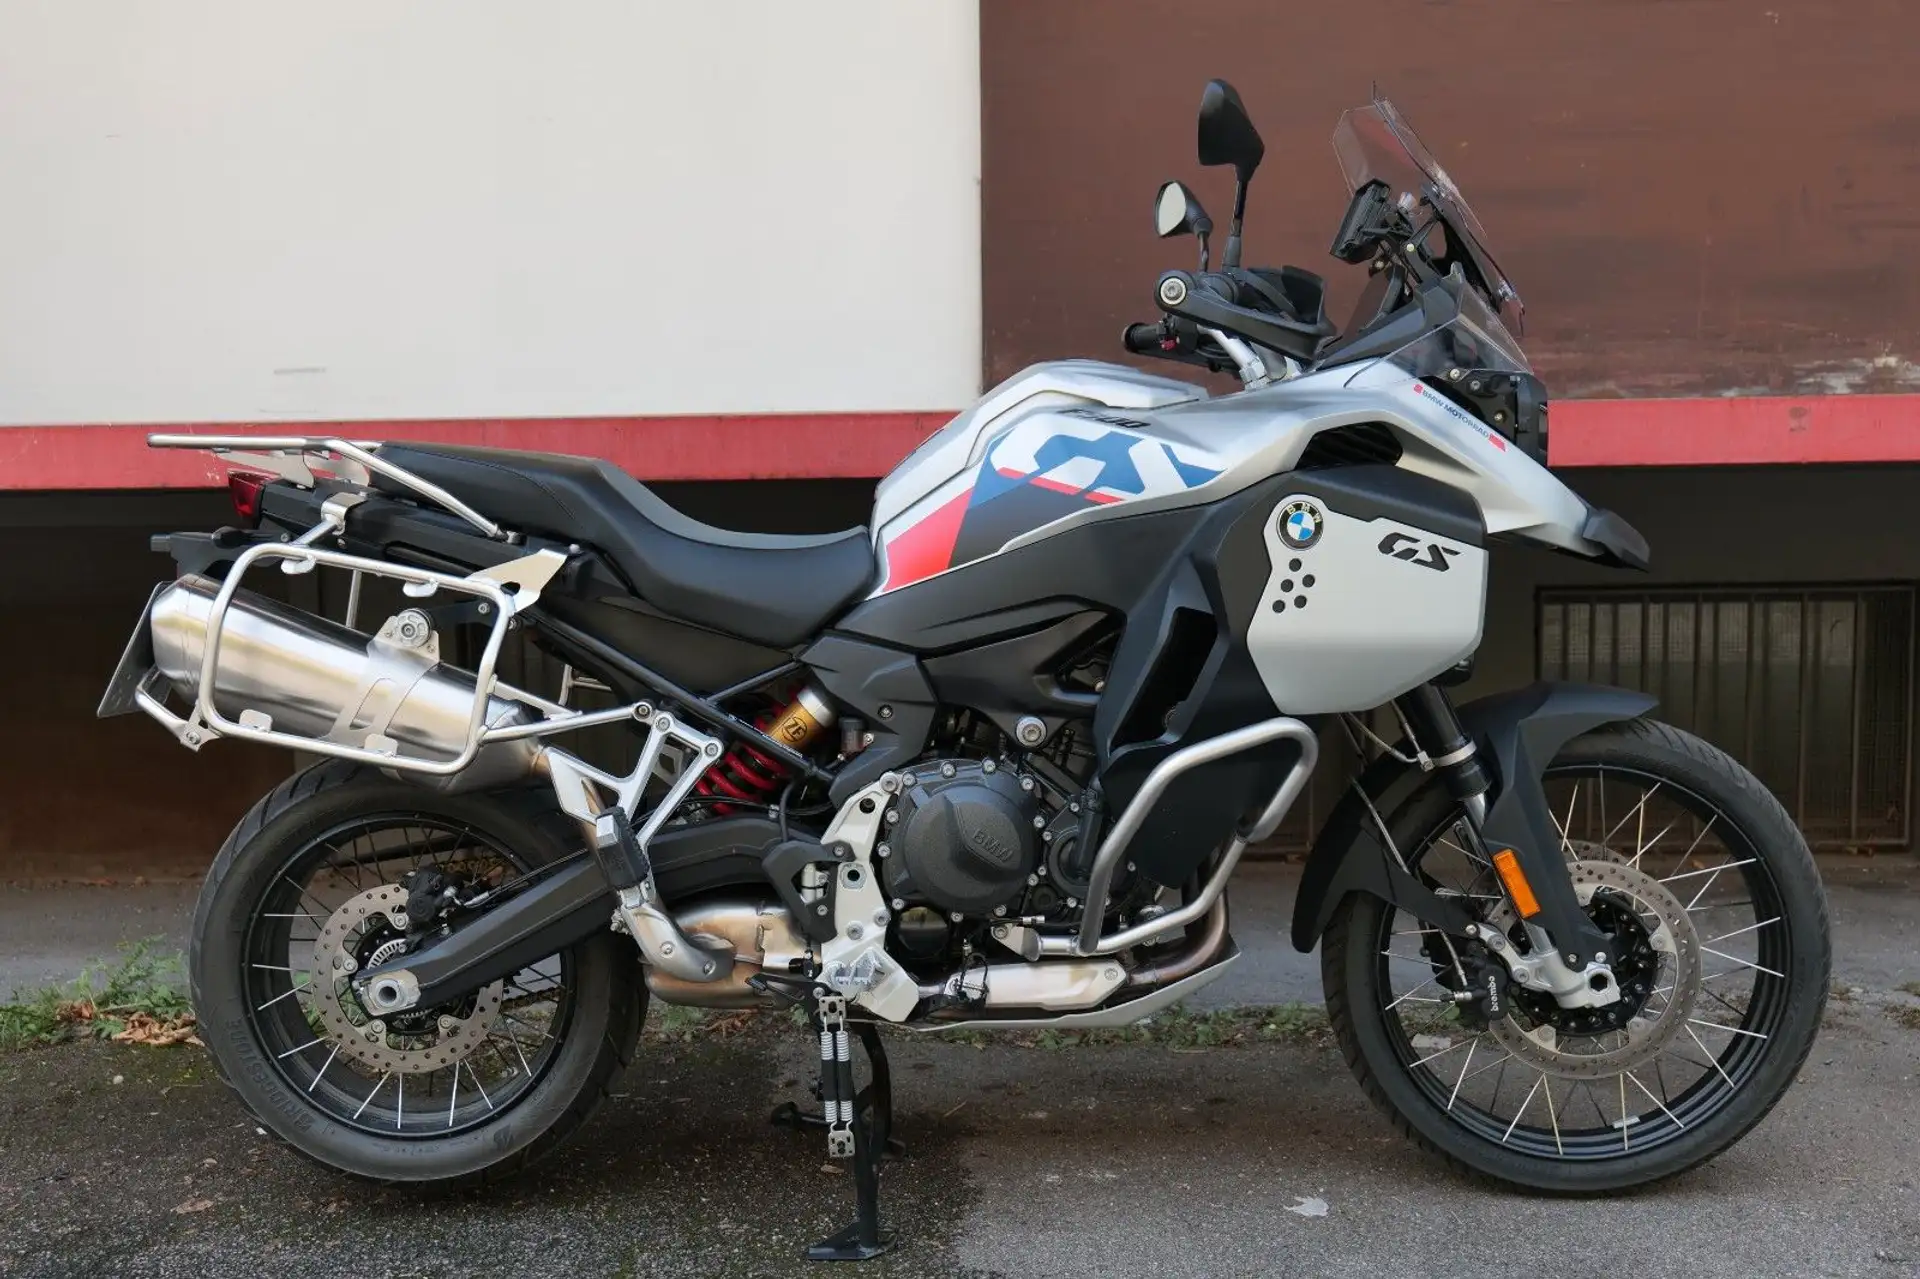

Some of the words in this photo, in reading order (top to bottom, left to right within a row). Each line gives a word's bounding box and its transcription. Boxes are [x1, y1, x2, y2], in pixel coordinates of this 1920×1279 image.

[1422, 390, 1443, 407] BMW
[1443, 402, 1489, 438] MOTORRAD
[1286, 502, 1322, 523] BMW
[1378, 532, 1460, 572] GS
[783, 717, 807, 741] ZF
[972, 828, 1013, 863] BMW
[1488, 975, 1499, 1012] brembo
